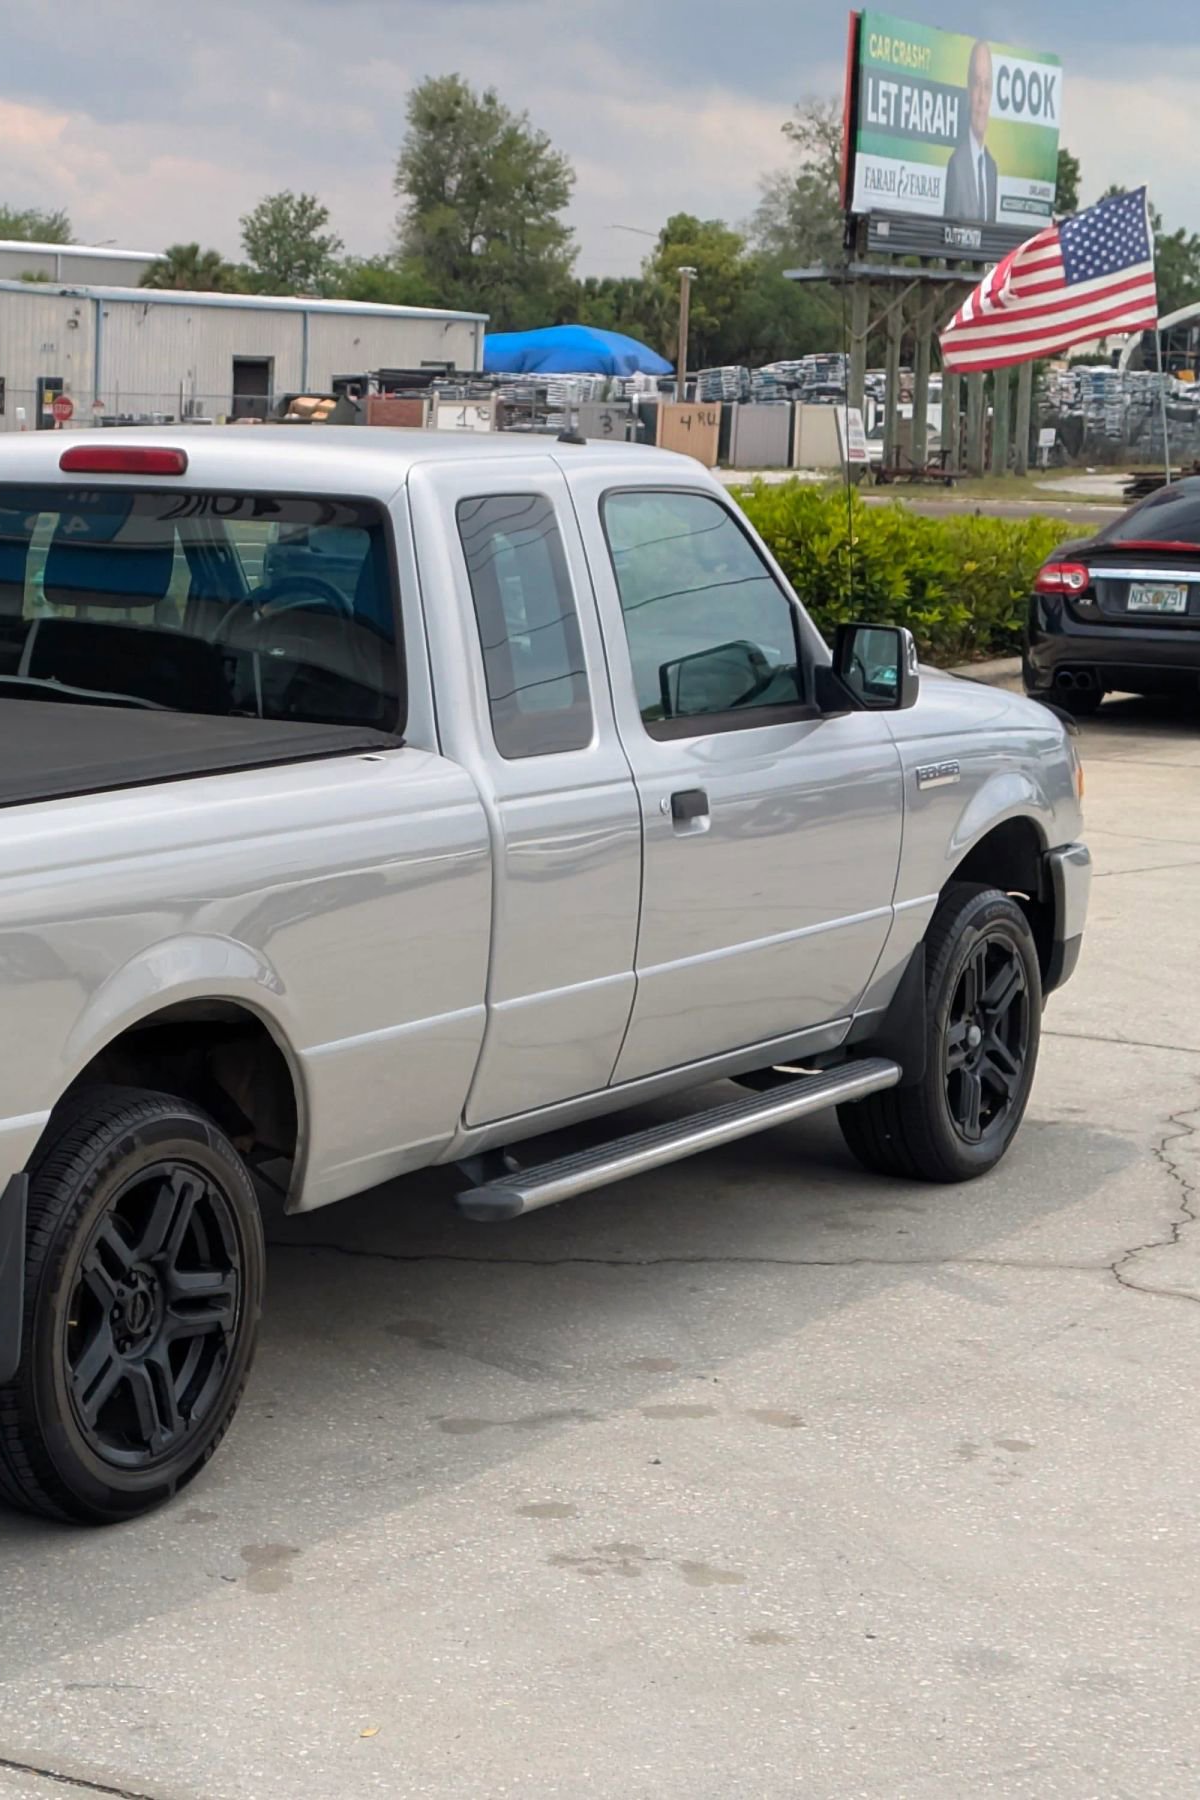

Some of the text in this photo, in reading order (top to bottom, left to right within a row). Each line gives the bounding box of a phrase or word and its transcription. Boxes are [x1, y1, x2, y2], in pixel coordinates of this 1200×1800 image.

[869, 33, 890, 62] CAR
[867, 77, 958, 138] LET FARAH
[996, 64, 1056, 120] COOK
[864, 166, 896, 193] FARAH
[909, 173, 940, 198] FARAH
[680, 415, 692, 432] 4
